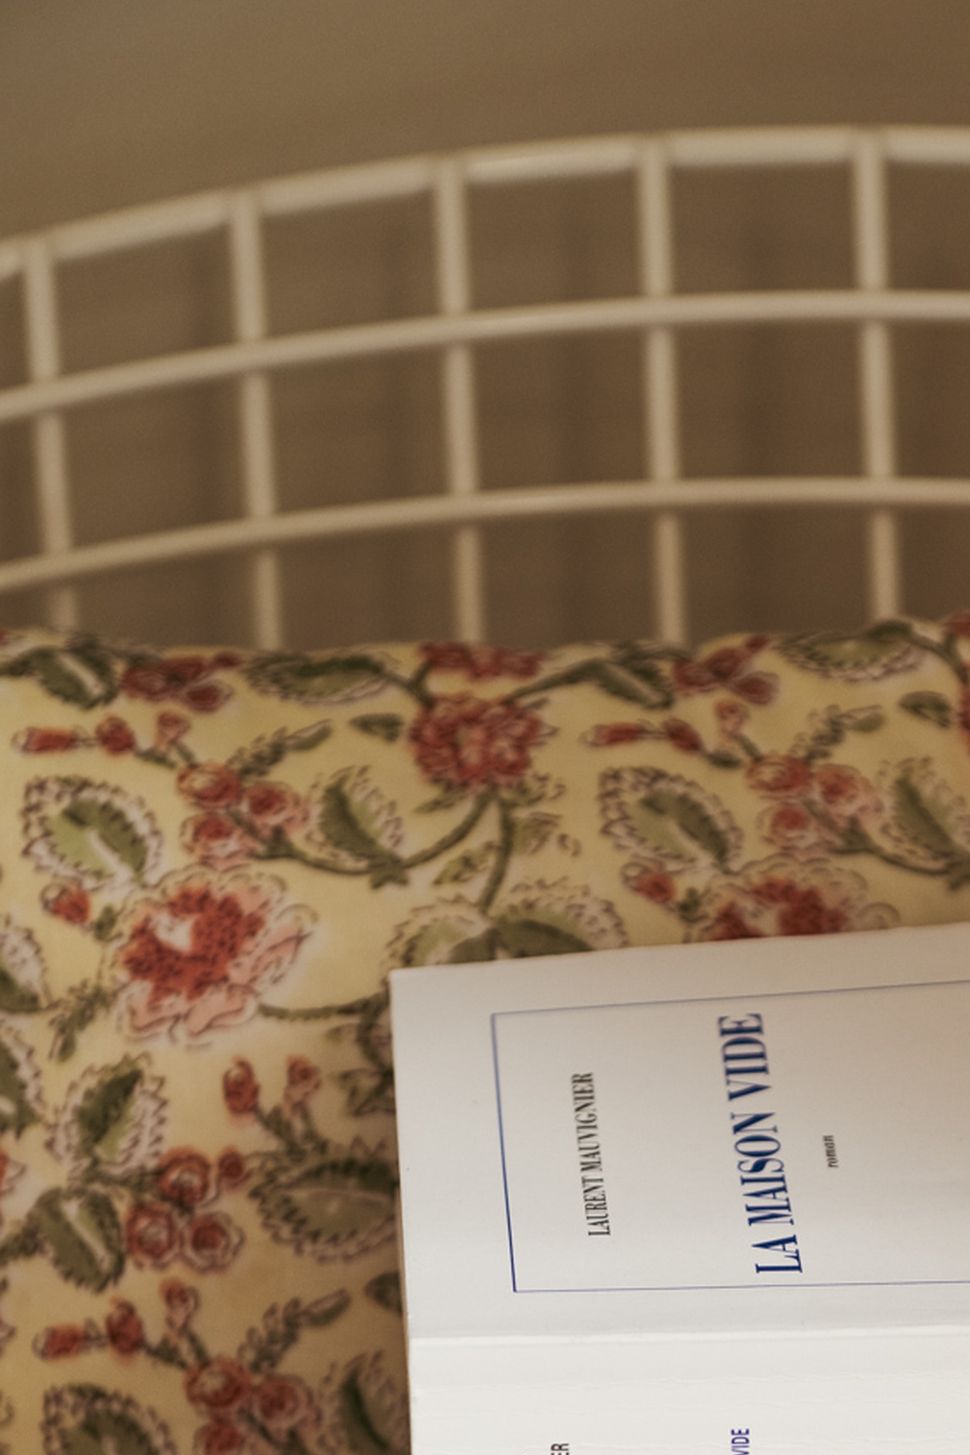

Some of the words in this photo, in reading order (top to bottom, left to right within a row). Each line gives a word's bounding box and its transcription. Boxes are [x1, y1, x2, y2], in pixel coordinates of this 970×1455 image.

[717, 1012, 773, 1102] VIDE
[570, 1071, 603, 1174] MAUVIGNIER
[823, 1135, 838, 1168] roman
[581, 1175, 612, 1237] LAURENT
[730, 1111, 797, 1227] MAISON
[752, 1234, 803, 1274] LA
